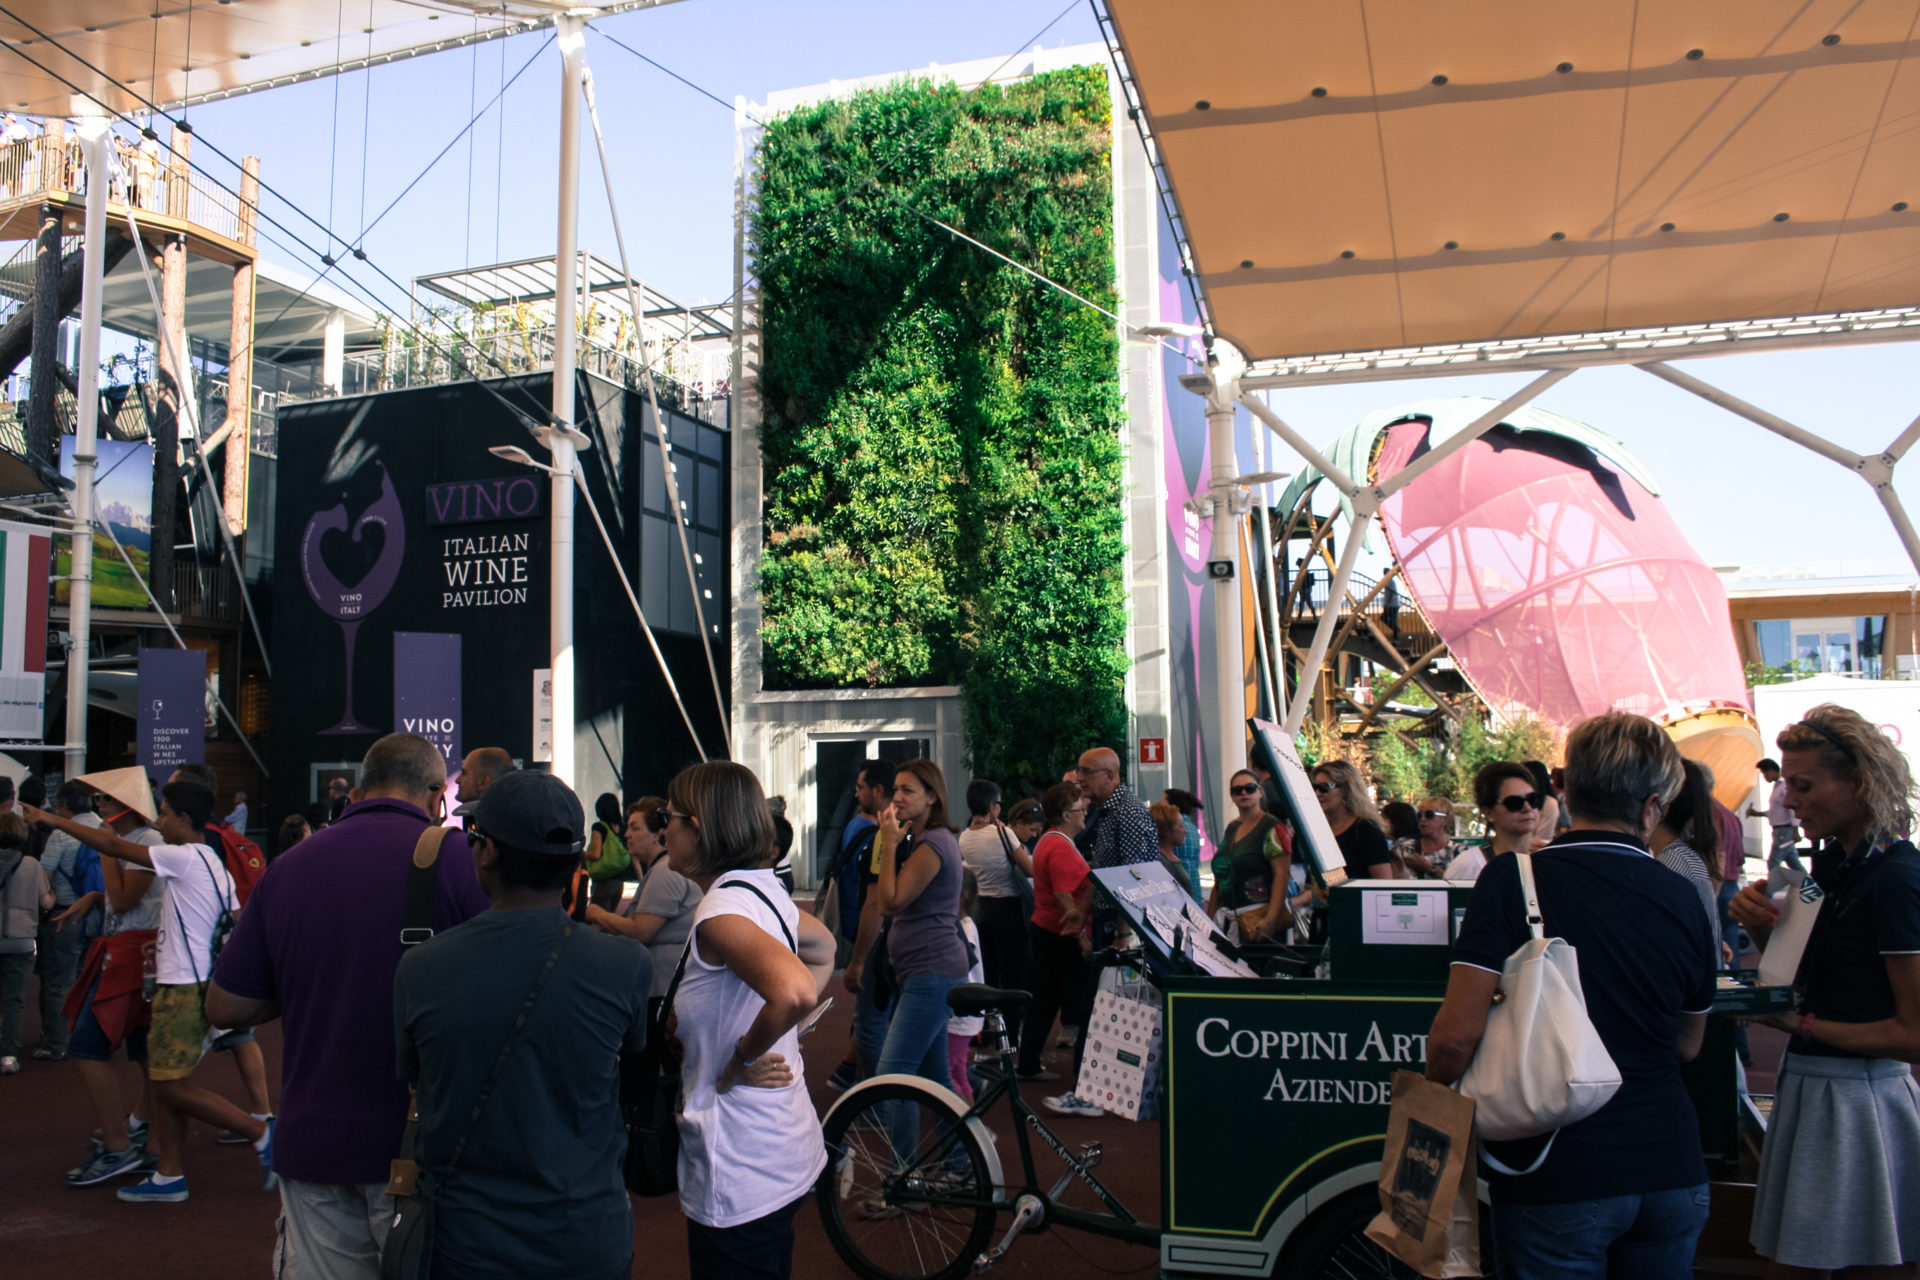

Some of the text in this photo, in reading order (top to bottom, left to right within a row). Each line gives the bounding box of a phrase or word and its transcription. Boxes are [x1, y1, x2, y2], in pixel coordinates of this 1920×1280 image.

[428, 478, 538, 522] VINO
[443, 533, 529, 557] ITALIAN
[443, 556, 529, 587] WINE
[340, 593, 362, 602] VINO
[442, 587, 528, 608] PAVILION
[340, 605, 361, 615] ITALY
[403, 718, 455, 733] VINO
[1196, 1017, 1429, 1063] COPPINI ART
[1263, 1068, 1392, 1105] AZIENDE
